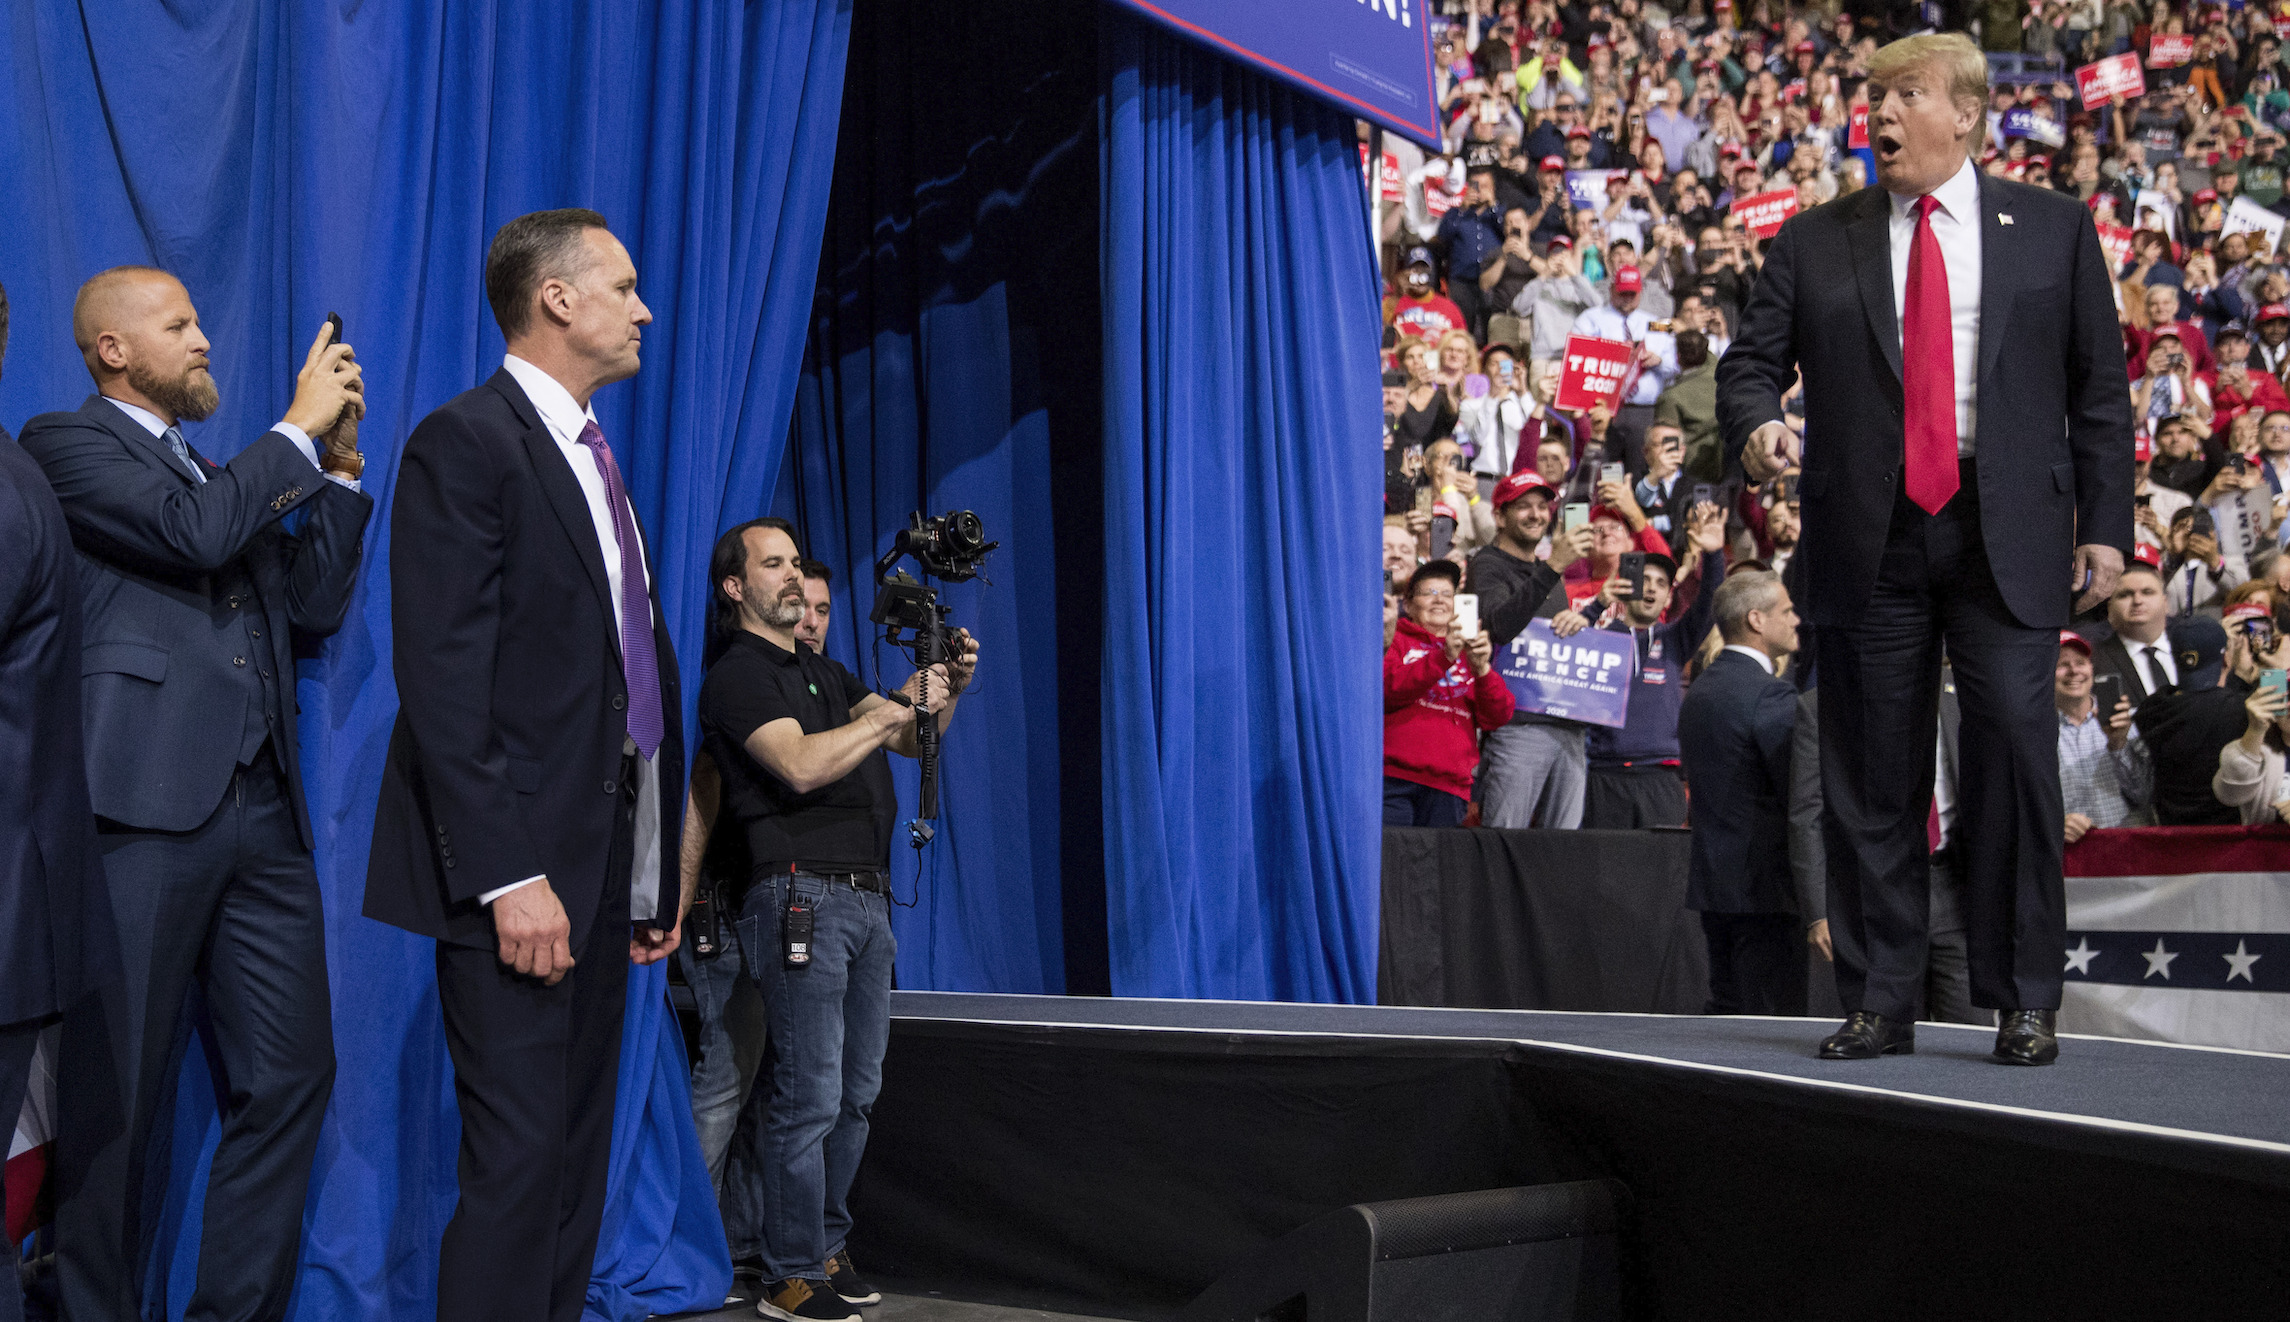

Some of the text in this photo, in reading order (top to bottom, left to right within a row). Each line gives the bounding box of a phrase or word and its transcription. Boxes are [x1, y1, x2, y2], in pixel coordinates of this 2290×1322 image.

[1734, 197, 1794, 219] TRUMP
[1511, 637, 1622, 670] TRUMP
[1502, 669, 1525, 679] MAKE
[1526, 672, 1562, 685] AMERICA
[1563, 678, 1589, 689] GREAT
[1515, 656, 1609, 683] PENCE
[1545, 705, 1568, 717] 2020
